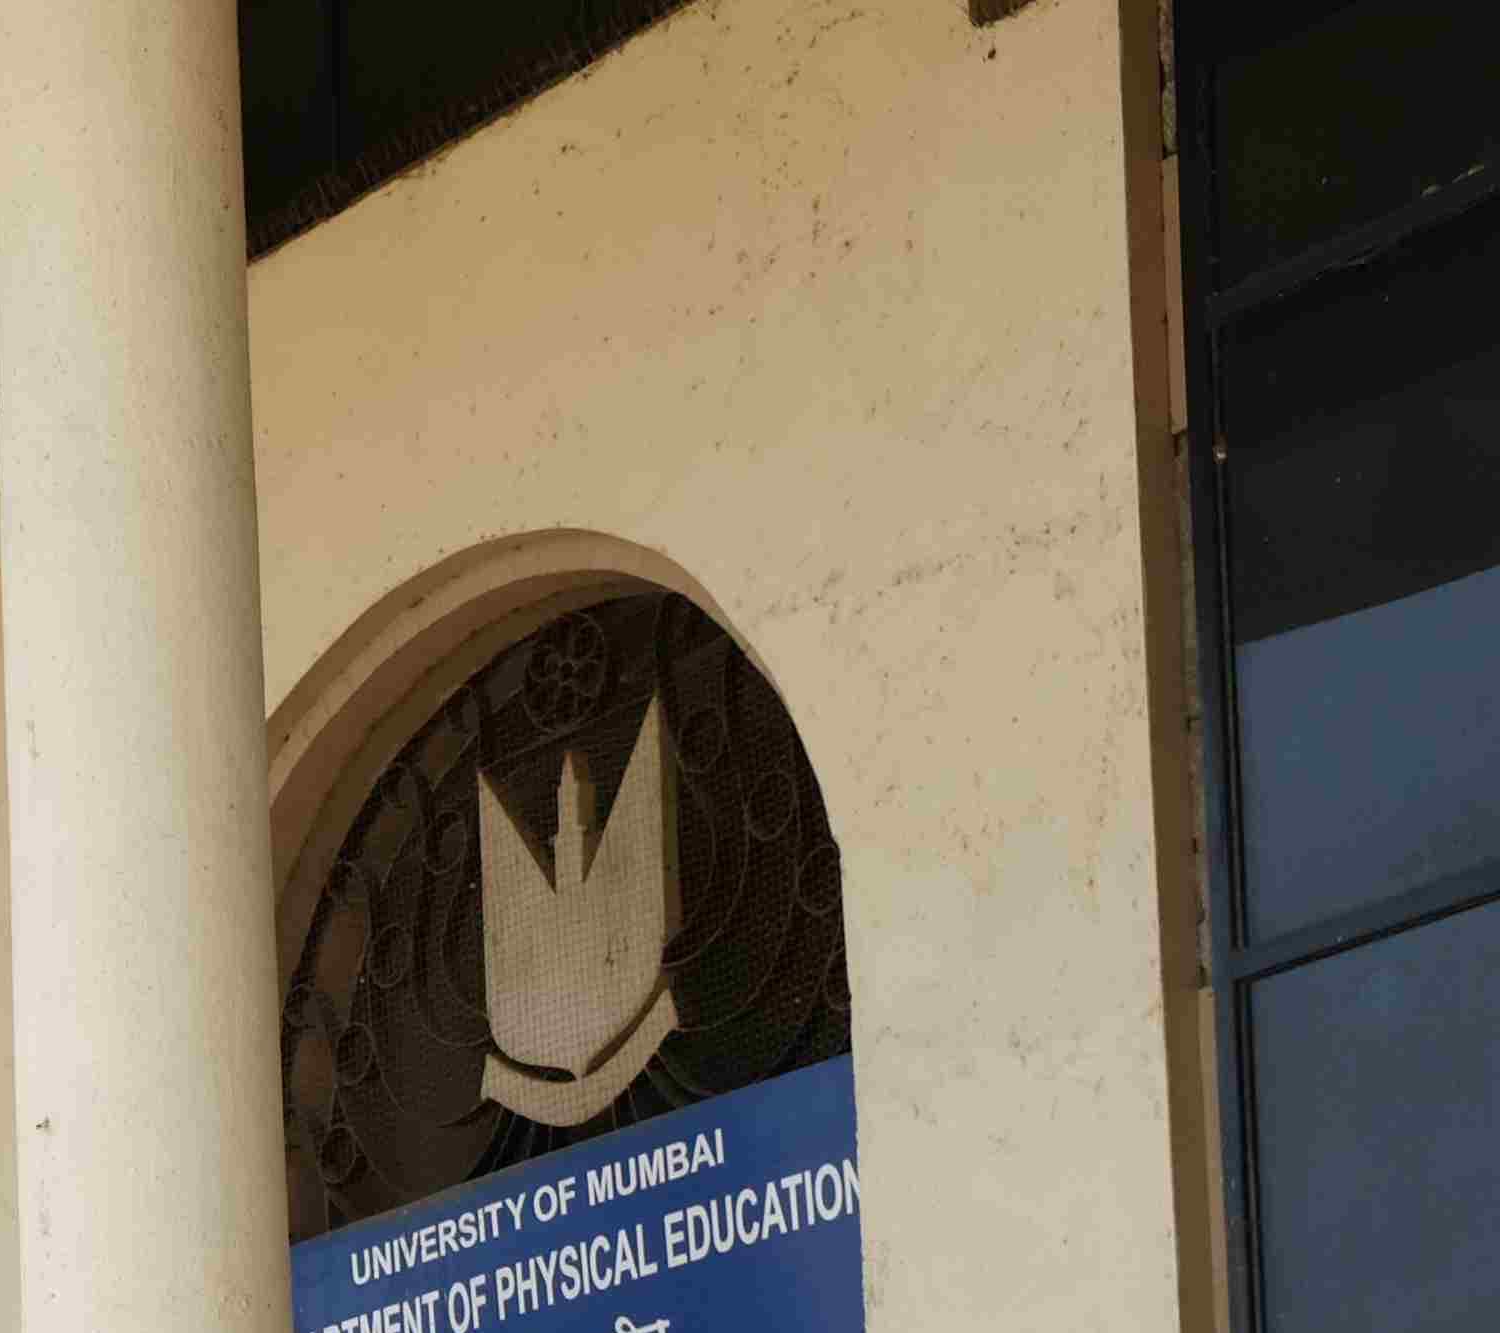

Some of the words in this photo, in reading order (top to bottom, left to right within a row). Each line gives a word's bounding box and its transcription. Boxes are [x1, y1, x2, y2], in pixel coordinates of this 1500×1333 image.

[351, 1192, 526, 1285] UNIVERSITY
[533, 1177, 576, 1222] OF
[587, 1128, 725, 1206] MUMBAI
[495, 1224, 658, 1321] PHYSICAL
[664, 1158, 860, 1268] EDUCATION
